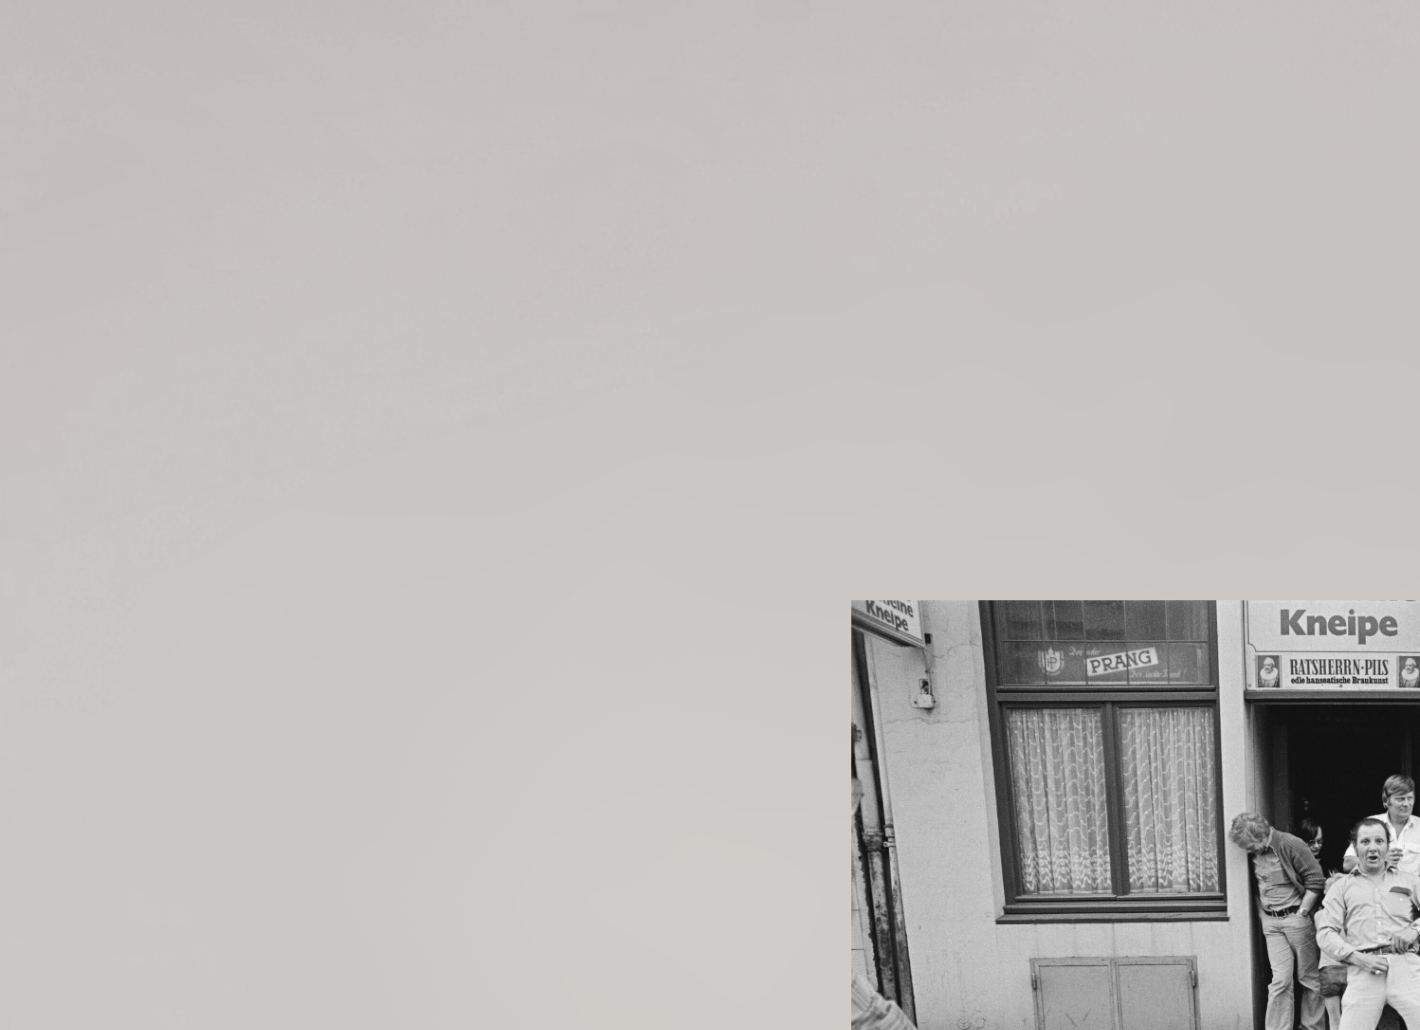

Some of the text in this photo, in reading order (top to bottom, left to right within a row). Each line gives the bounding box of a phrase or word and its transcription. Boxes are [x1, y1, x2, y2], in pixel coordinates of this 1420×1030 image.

[865, 600, 909, 632] Kneipe
[879, 600, 914, 618] eine
[1280, 608, 1398, 645] Kneipe
[1089, 649, 1152, 674] PRANG
[1291, 676, 1389, 684] edle hanseatische Braukunst
